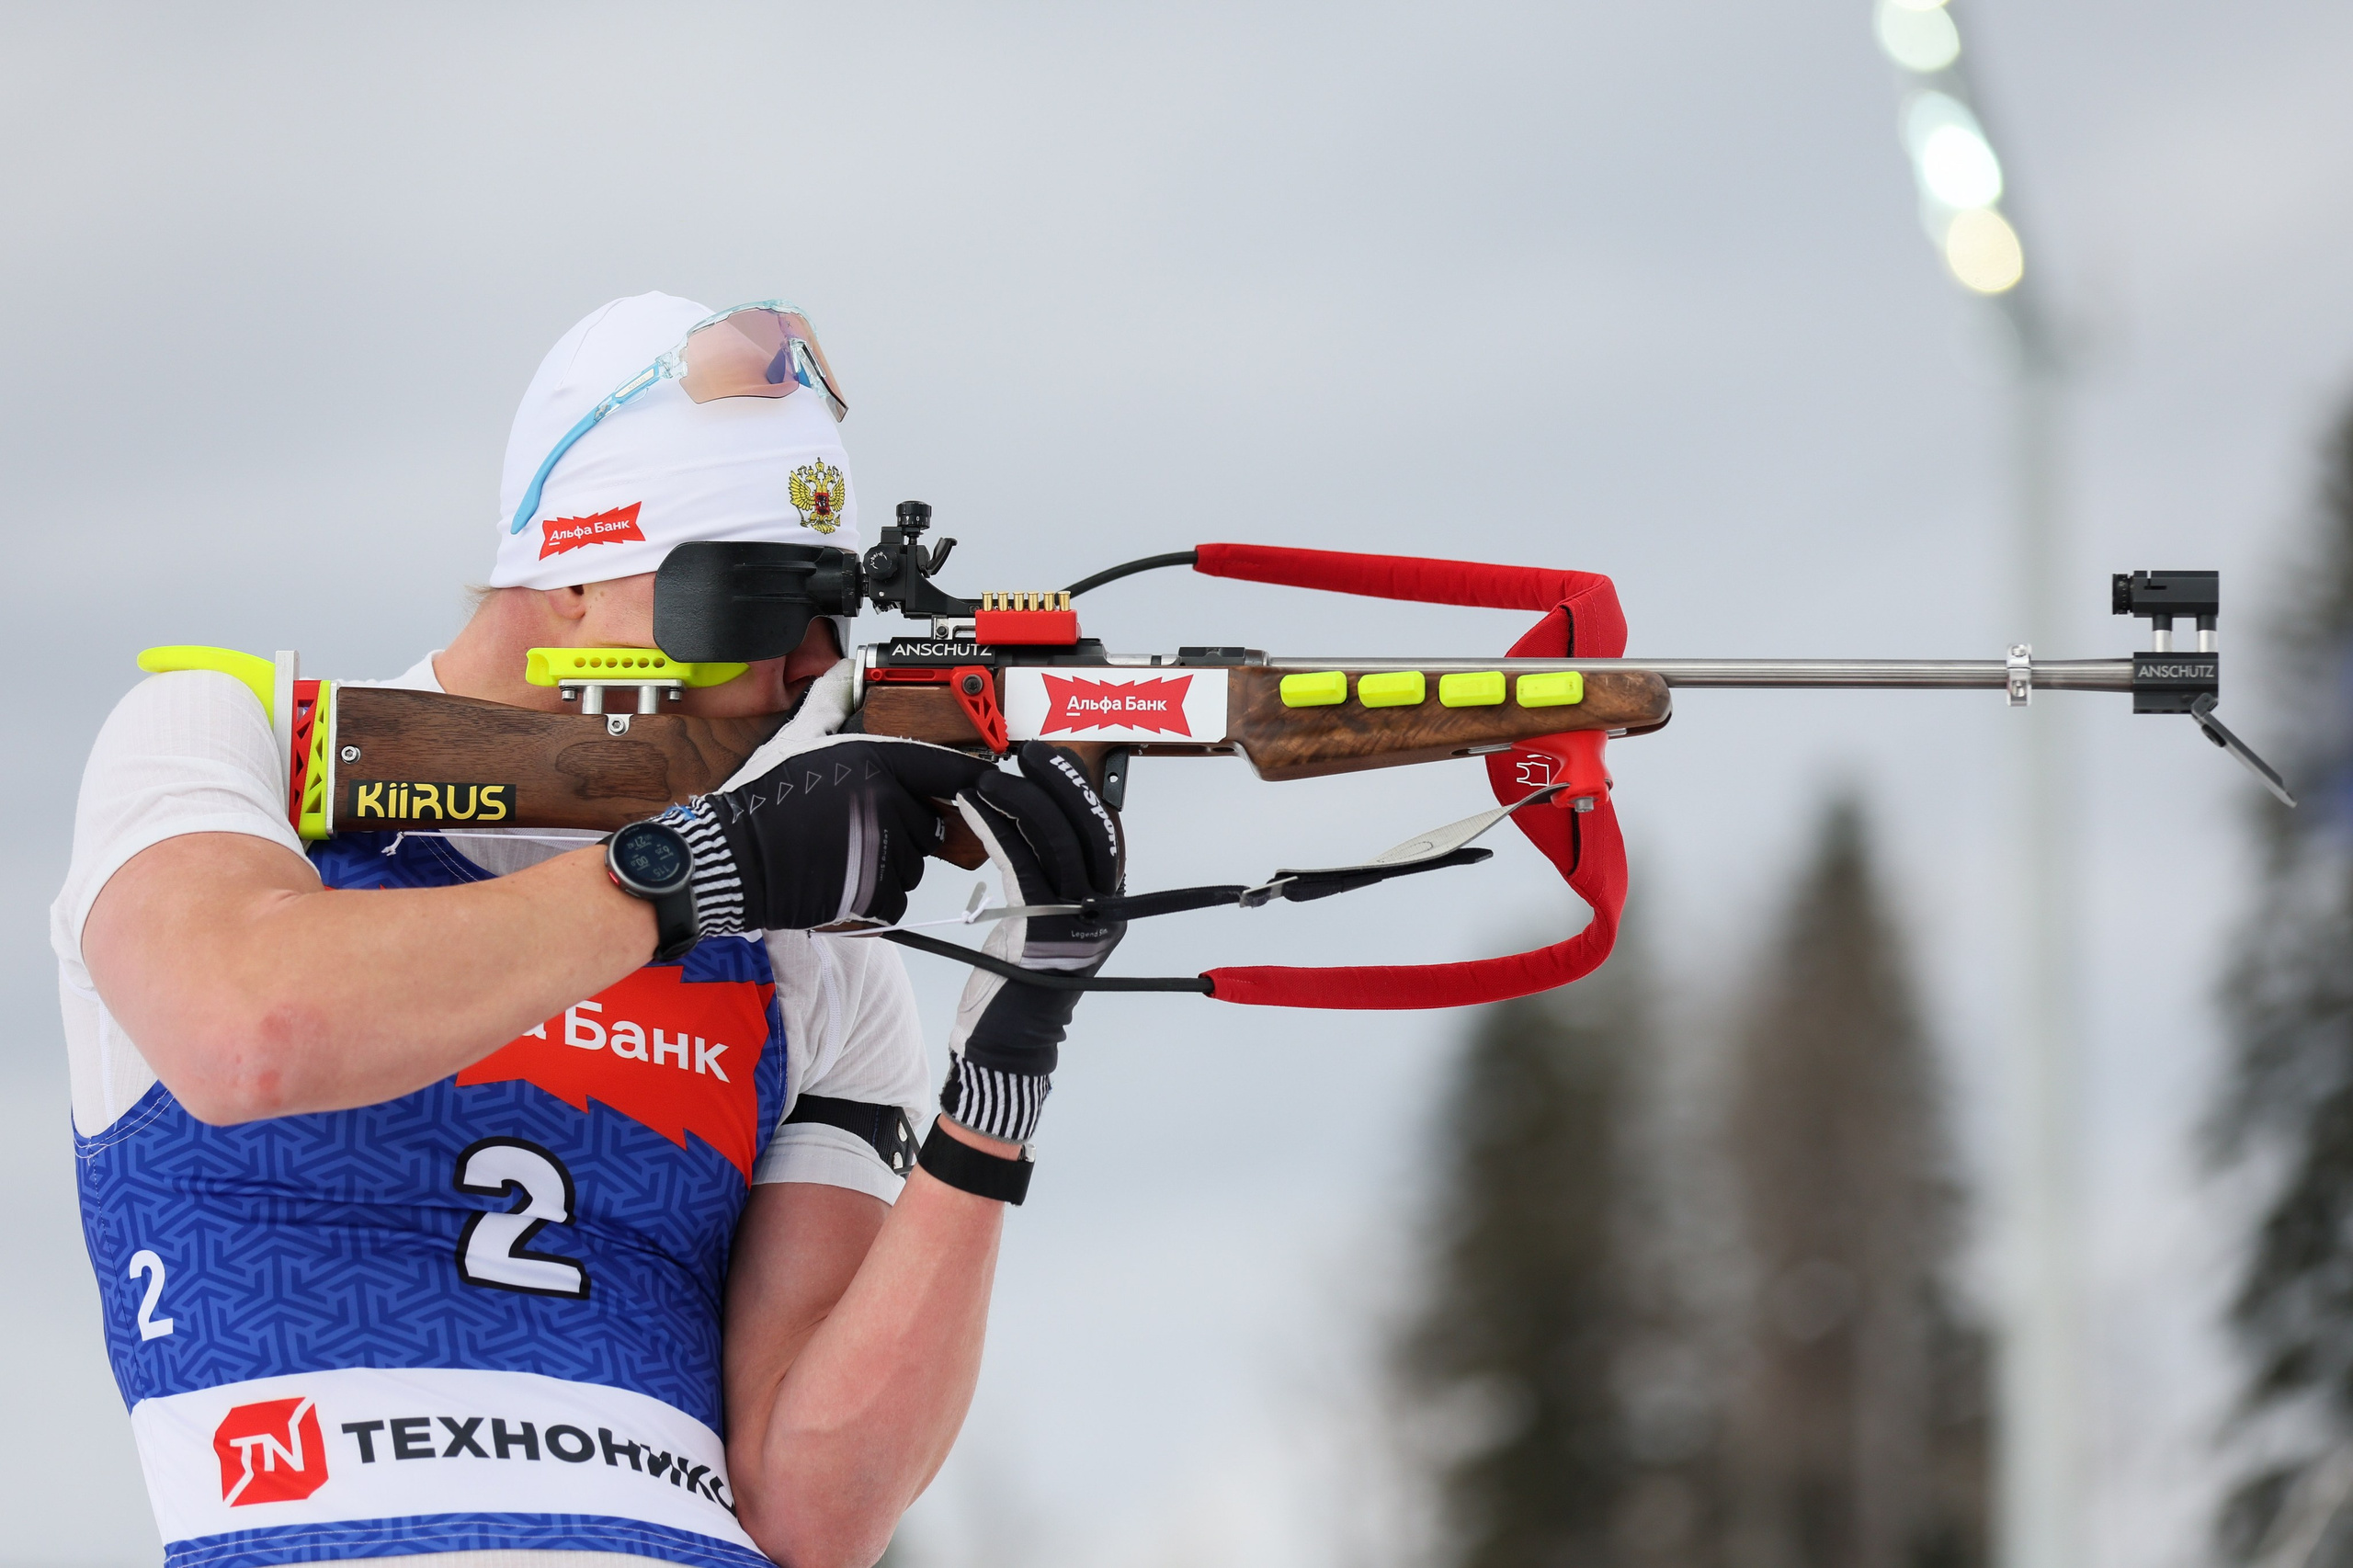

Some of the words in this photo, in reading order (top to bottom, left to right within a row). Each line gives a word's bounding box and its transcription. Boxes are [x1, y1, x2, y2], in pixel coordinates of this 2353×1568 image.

[549, 525, 593, 545] Альфа
[594, 519, 631, 534] Банк
[891, 642, 993, 656] ANSCHÜTZ
[2137, 665, 2215, 678] ANSCHÜTZ
[1065, 695, 1122, 716] Альфа
[1125, 696, 1167, 711] Банк
[564, 999, 731, 1084] Банк
[455, 1136, 591, 1301] 2
[129, 1249, 174, 1342] 2
